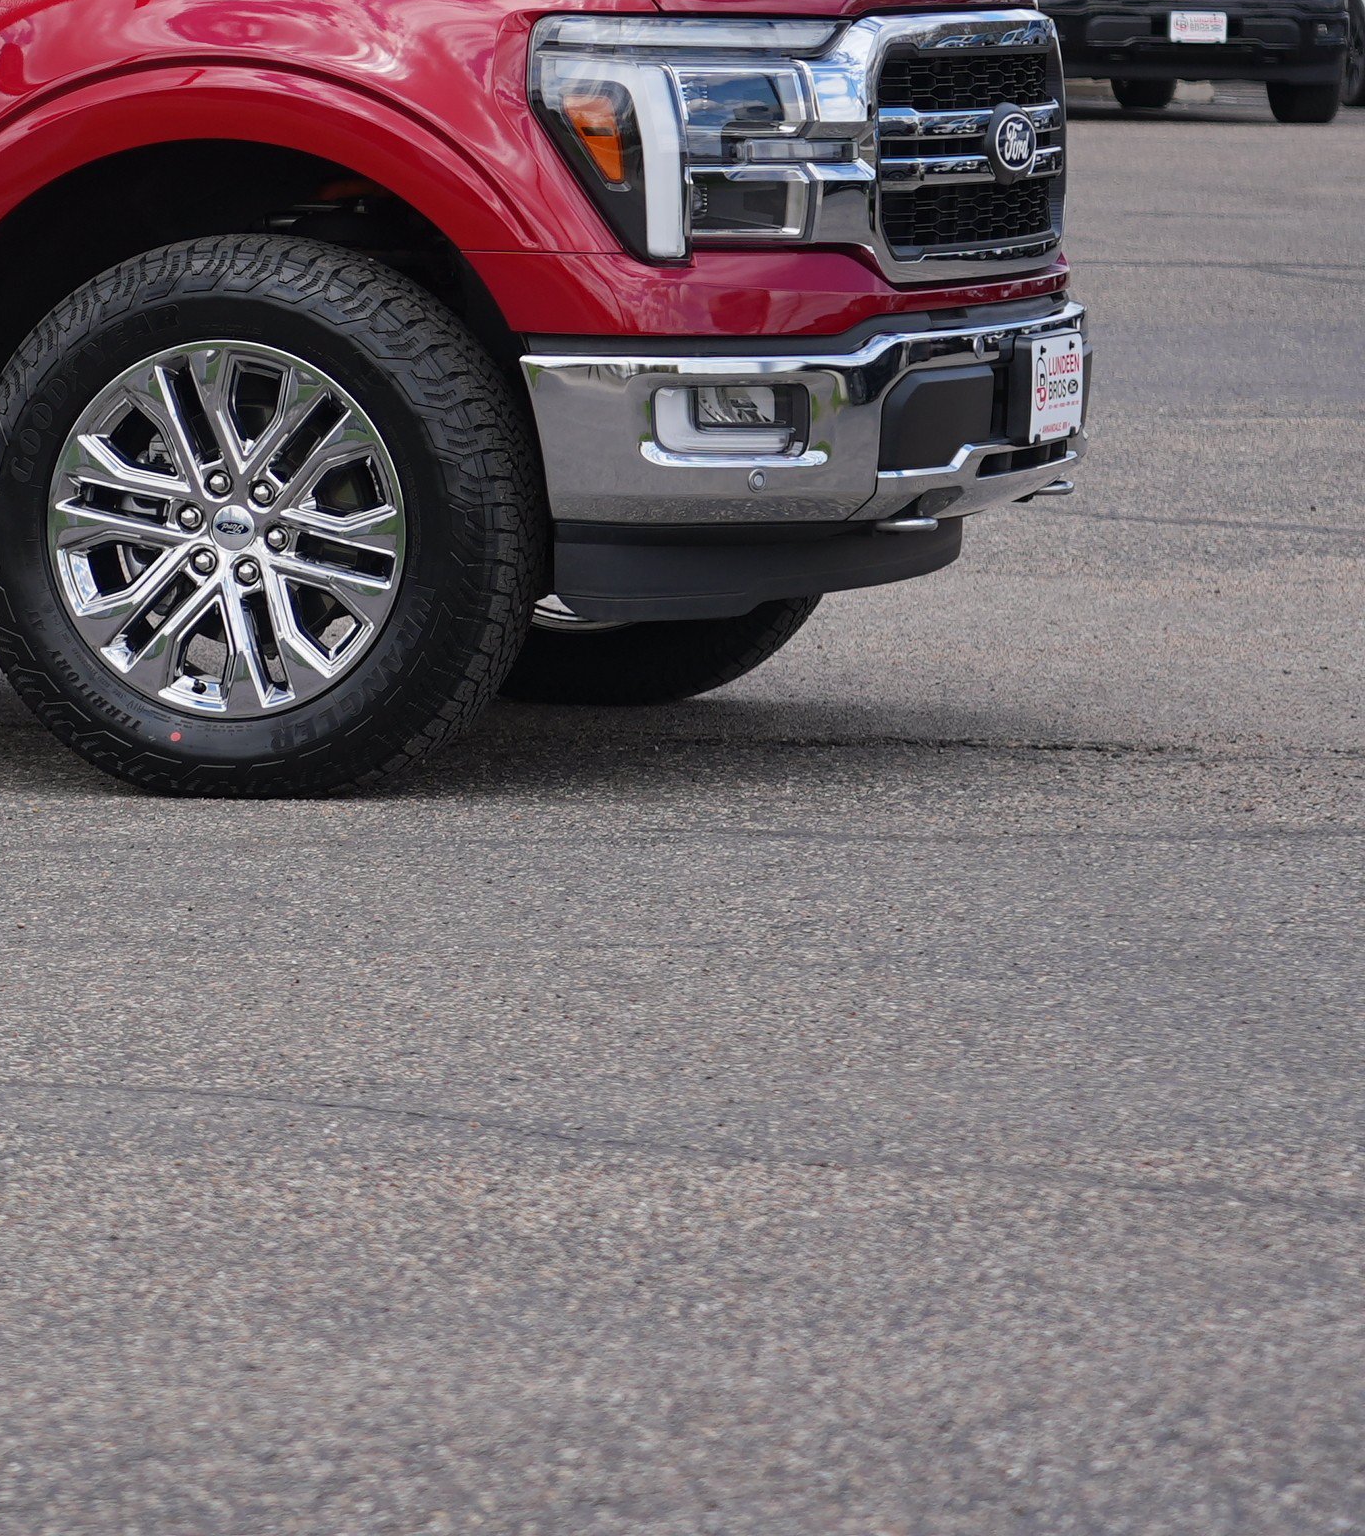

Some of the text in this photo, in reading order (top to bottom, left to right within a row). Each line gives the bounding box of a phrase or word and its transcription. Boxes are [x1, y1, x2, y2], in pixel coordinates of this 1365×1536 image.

[1004, 121, 1030, 161] Ford
[1048, 353, 1080, 376] LUNDEEN
[11, 302, 181, 483] GOODYEAR
[1048, 379, 1067, 400] BROS
[221, 522, 245, 535] Ford
[270, 584, 437, 753] WRANGLER
[46, 648, 143, 734] TERRITORY
